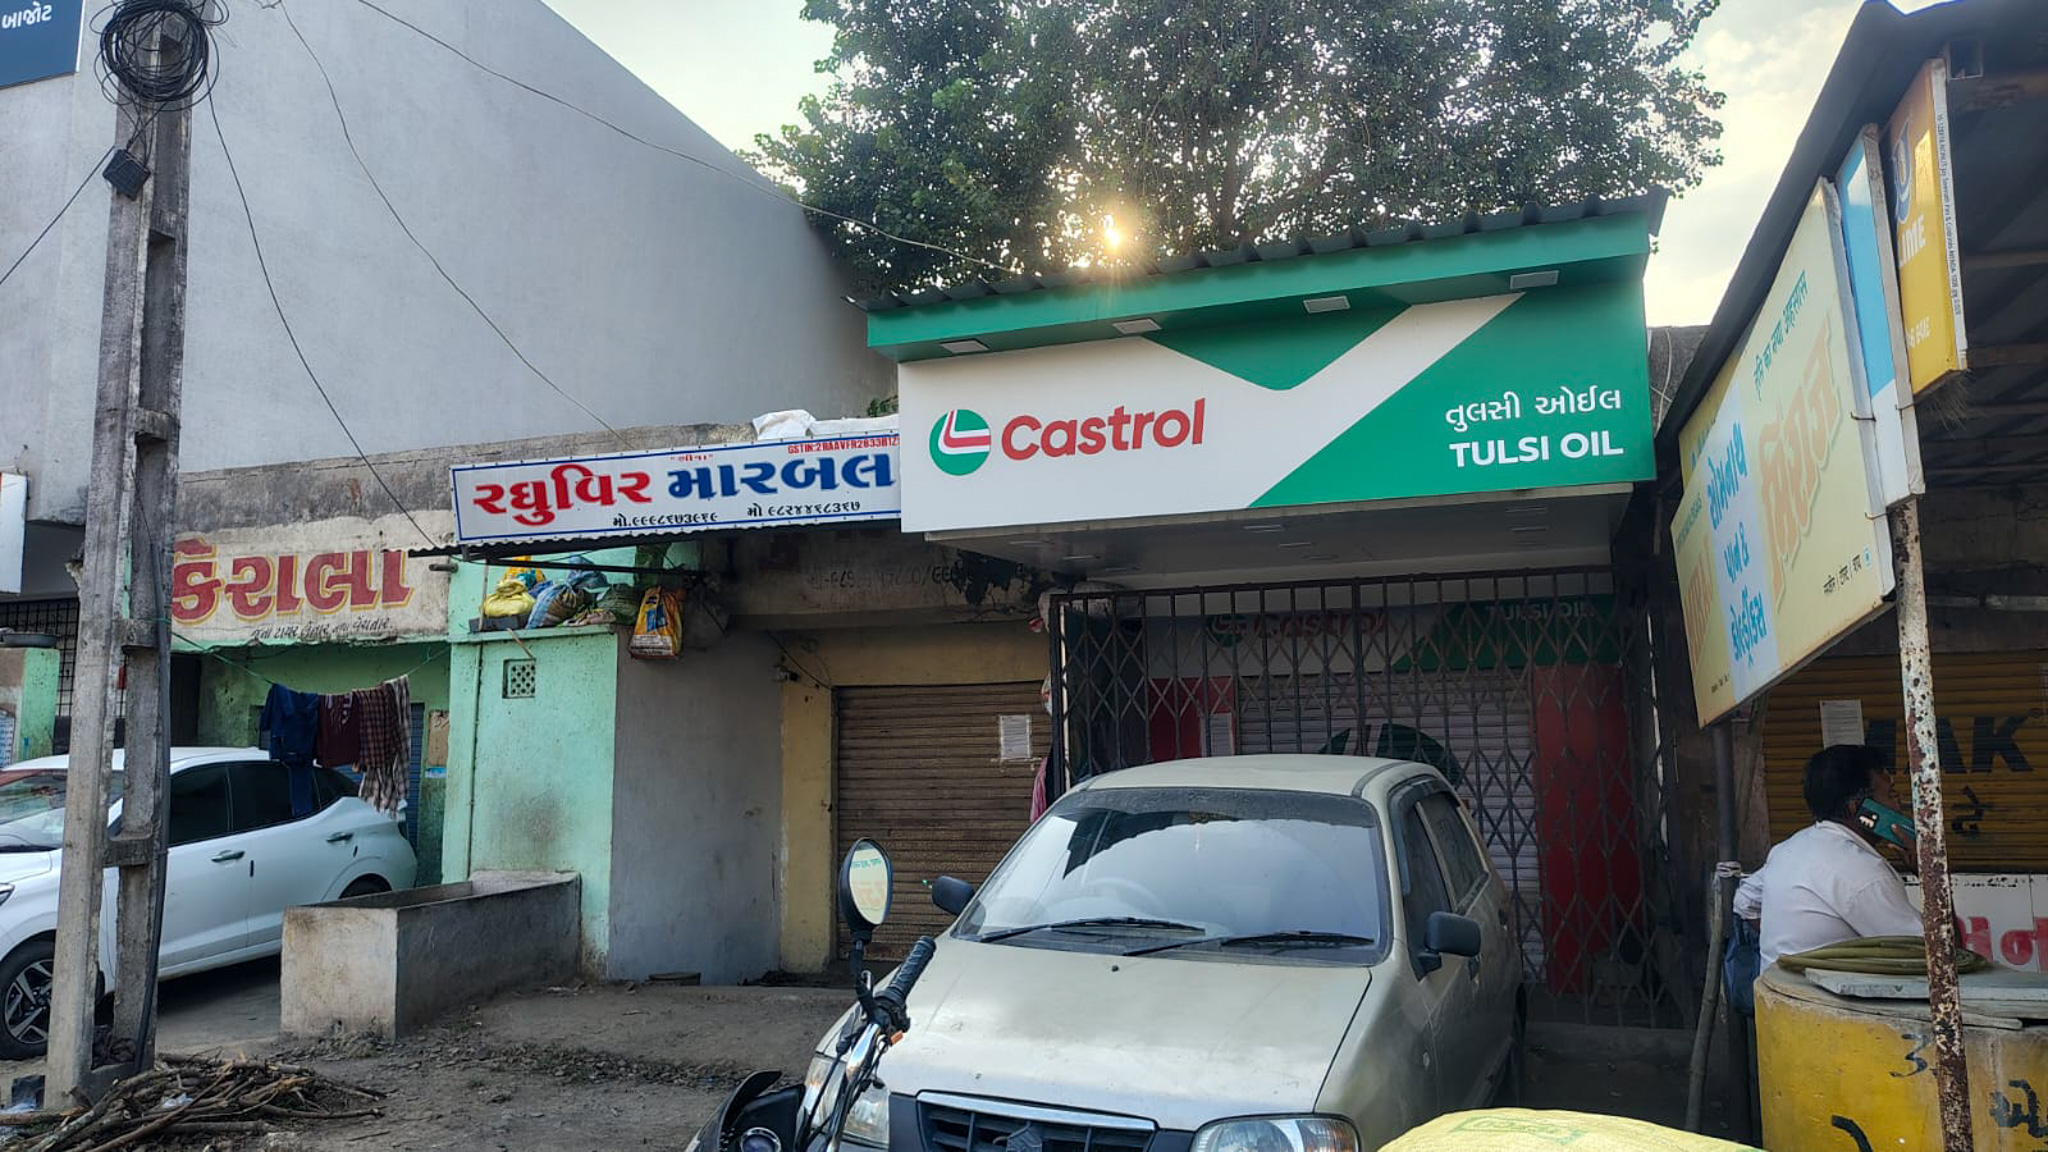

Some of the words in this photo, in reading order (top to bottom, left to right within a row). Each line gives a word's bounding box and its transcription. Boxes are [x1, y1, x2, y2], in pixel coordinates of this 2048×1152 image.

[1001, 397, 1205, 461] Castrol
[1446, 391, 1521, 432] તુલસી
[1535, 385, 1621, 414] ઓઈલ
[1449, 435, 1549, 467] TULSI
[1560, 430, 1624, 458] OIL
[472, 463, 653, 527] રઘુવિર
[667, 453, 896, 501] મારબલ
